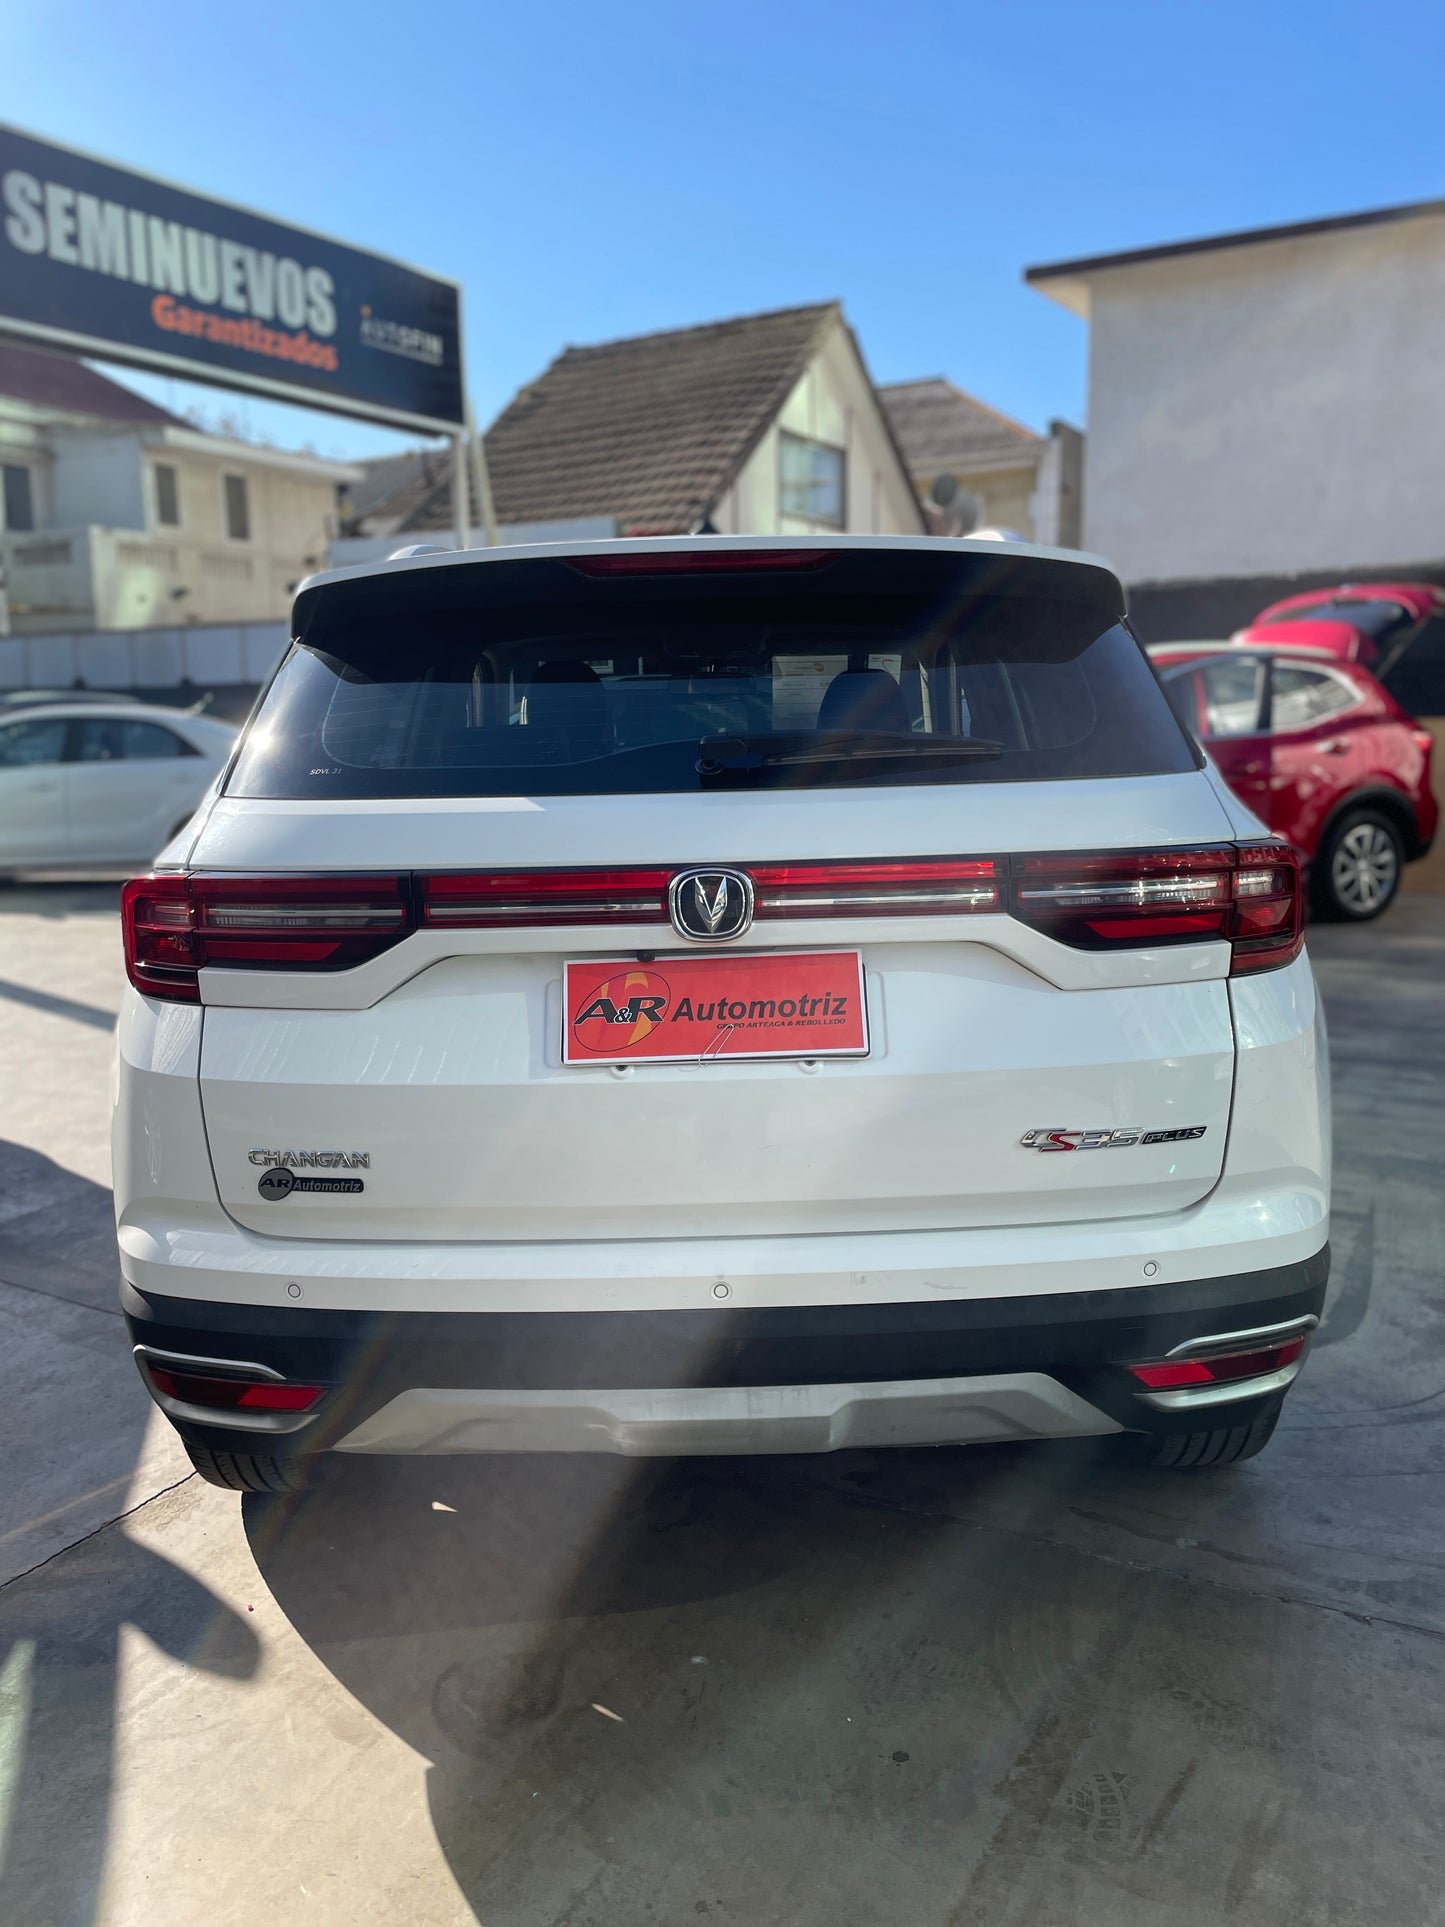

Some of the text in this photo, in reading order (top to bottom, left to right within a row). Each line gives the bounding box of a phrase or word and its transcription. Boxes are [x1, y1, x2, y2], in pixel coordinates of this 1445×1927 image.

[2, 170, 337, 338] SEMINUEVOS
[150, 294, 338, 372] Garantizados
[573, 992, 847, 1025] A&R Automotriz
[746, 1020, 786, 1028] ARTEAGA
[795, 1018, 846, 1027] REBOLLEDO
[1020, 1127, 1205, 1152] CS35 PLUS
[248, 1149, 371, 1169] CHANGAN
[293, 1180, 361, 1192] Automotriz
